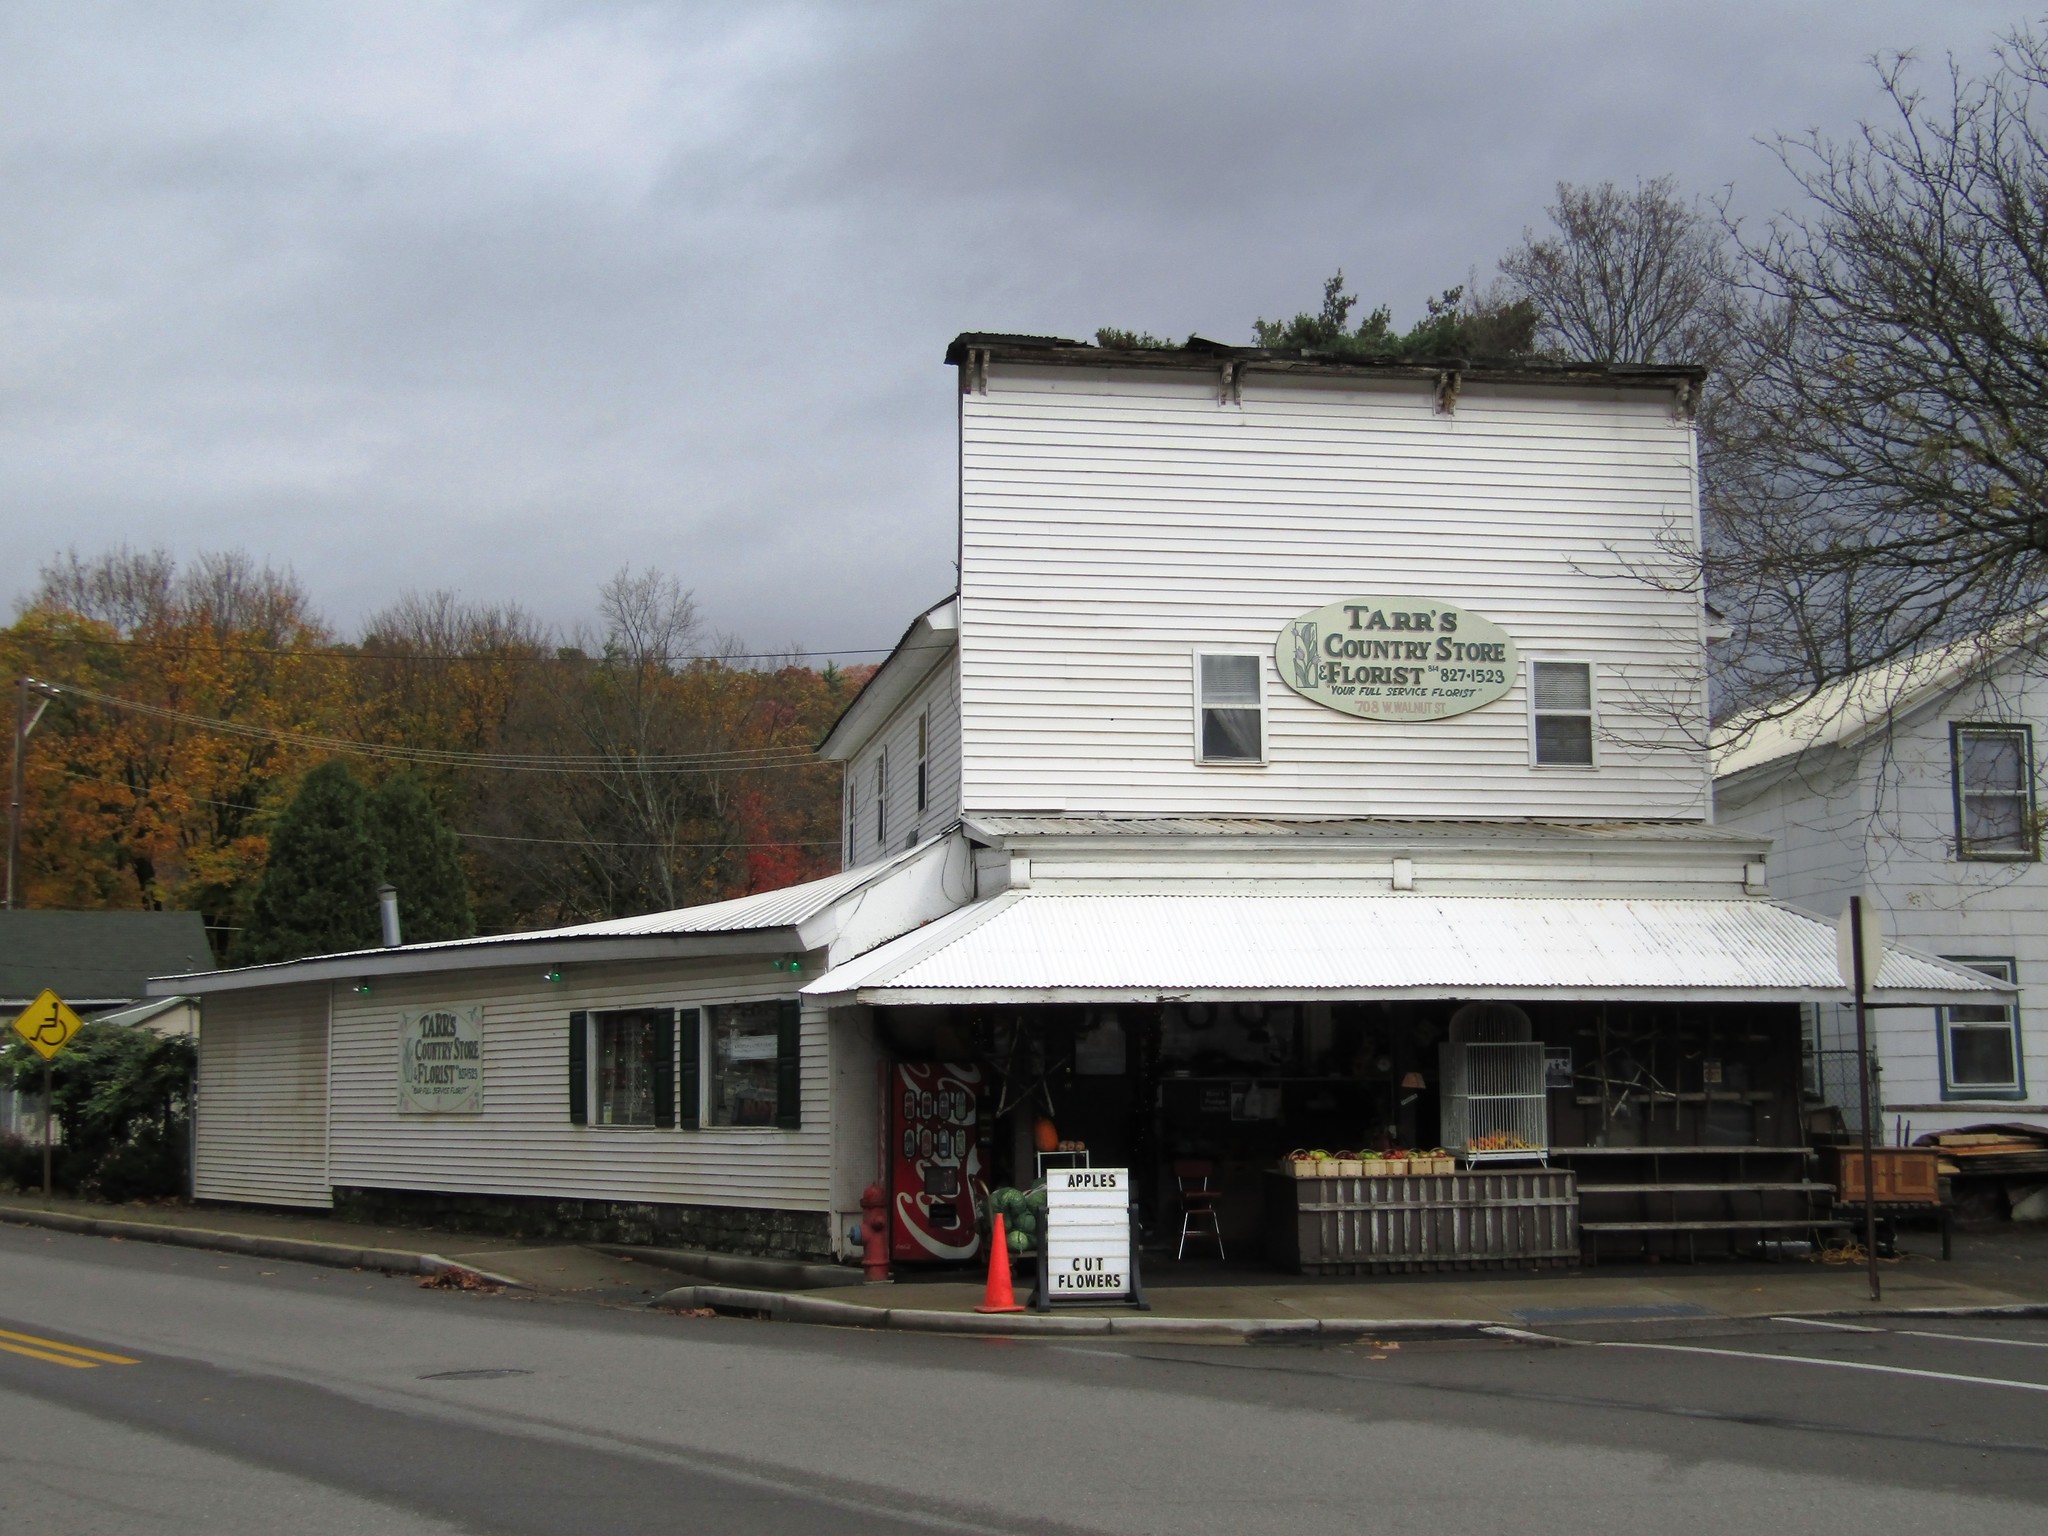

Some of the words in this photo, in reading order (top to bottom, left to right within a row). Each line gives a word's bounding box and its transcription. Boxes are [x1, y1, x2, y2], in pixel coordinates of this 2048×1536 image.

[1343, 605, 1457, 632] TARR'S
[1325, 632, 1431, 660] COUNTRY
[1436, 636, 1506, 662] STORE
[1326, 661, 1425, 685] FLORIST
[1428, 664, 1439, 673] 814
[1359, 686, 1381, 696] FULL
[1386, 687, 1428, 697] SERVICE
[1355, 700, 1379, 713] 708
[415, 1039, 453, 1060] COUNTRY
[453, 1037, 479, 1060] STORE
[418, 1063, 456, 1084] FLORIST
[1068, 1174, 1116, 1188] APPLES
[1072, 1257, 1104, 1271] CUT
[1058, 1274, 1121, 1288] FLOWERS
